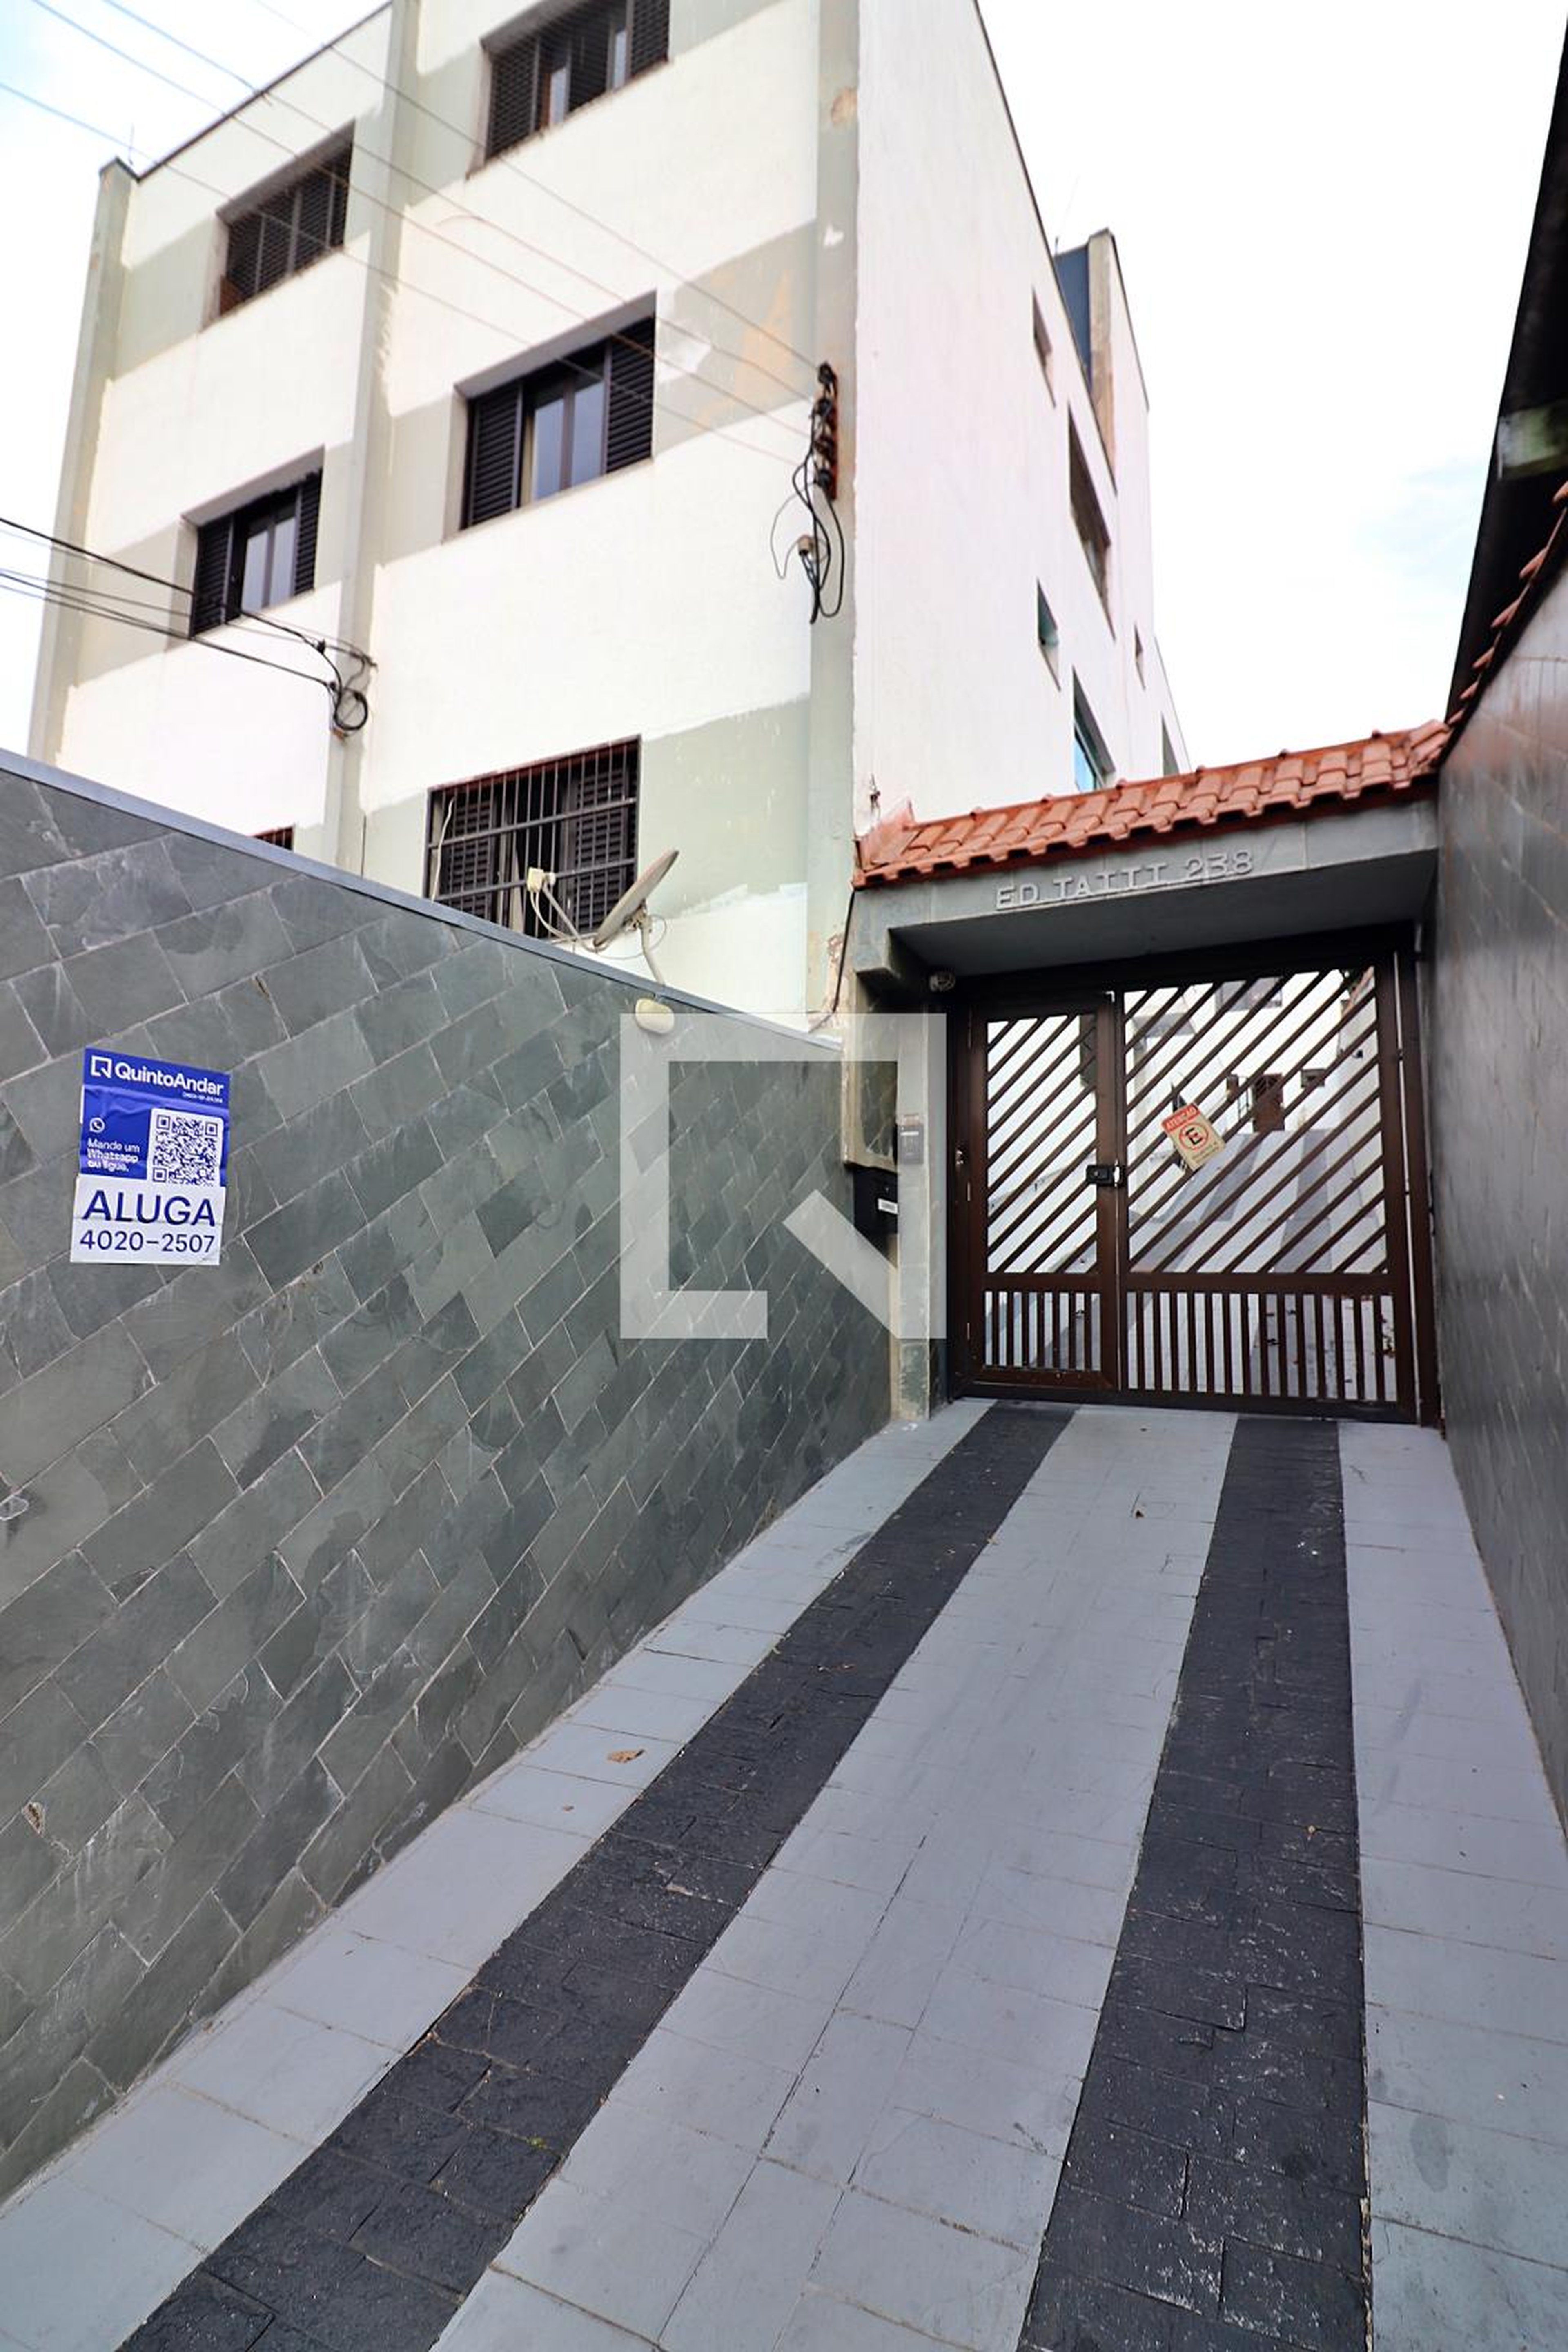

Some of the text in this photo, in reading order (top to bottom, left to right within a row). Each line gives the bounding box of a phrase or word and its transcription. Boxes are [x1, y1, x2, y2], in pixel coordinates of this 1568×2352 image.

[997, 883, 1039, 909] ED
[114, 1062, 224, 1096] QuintoAndar
[87, 1138, 122, 1150] Mande
[82, 1189, 216, 1227] ALUGA
[80, 1229, 215, 1253] 4020-2507
